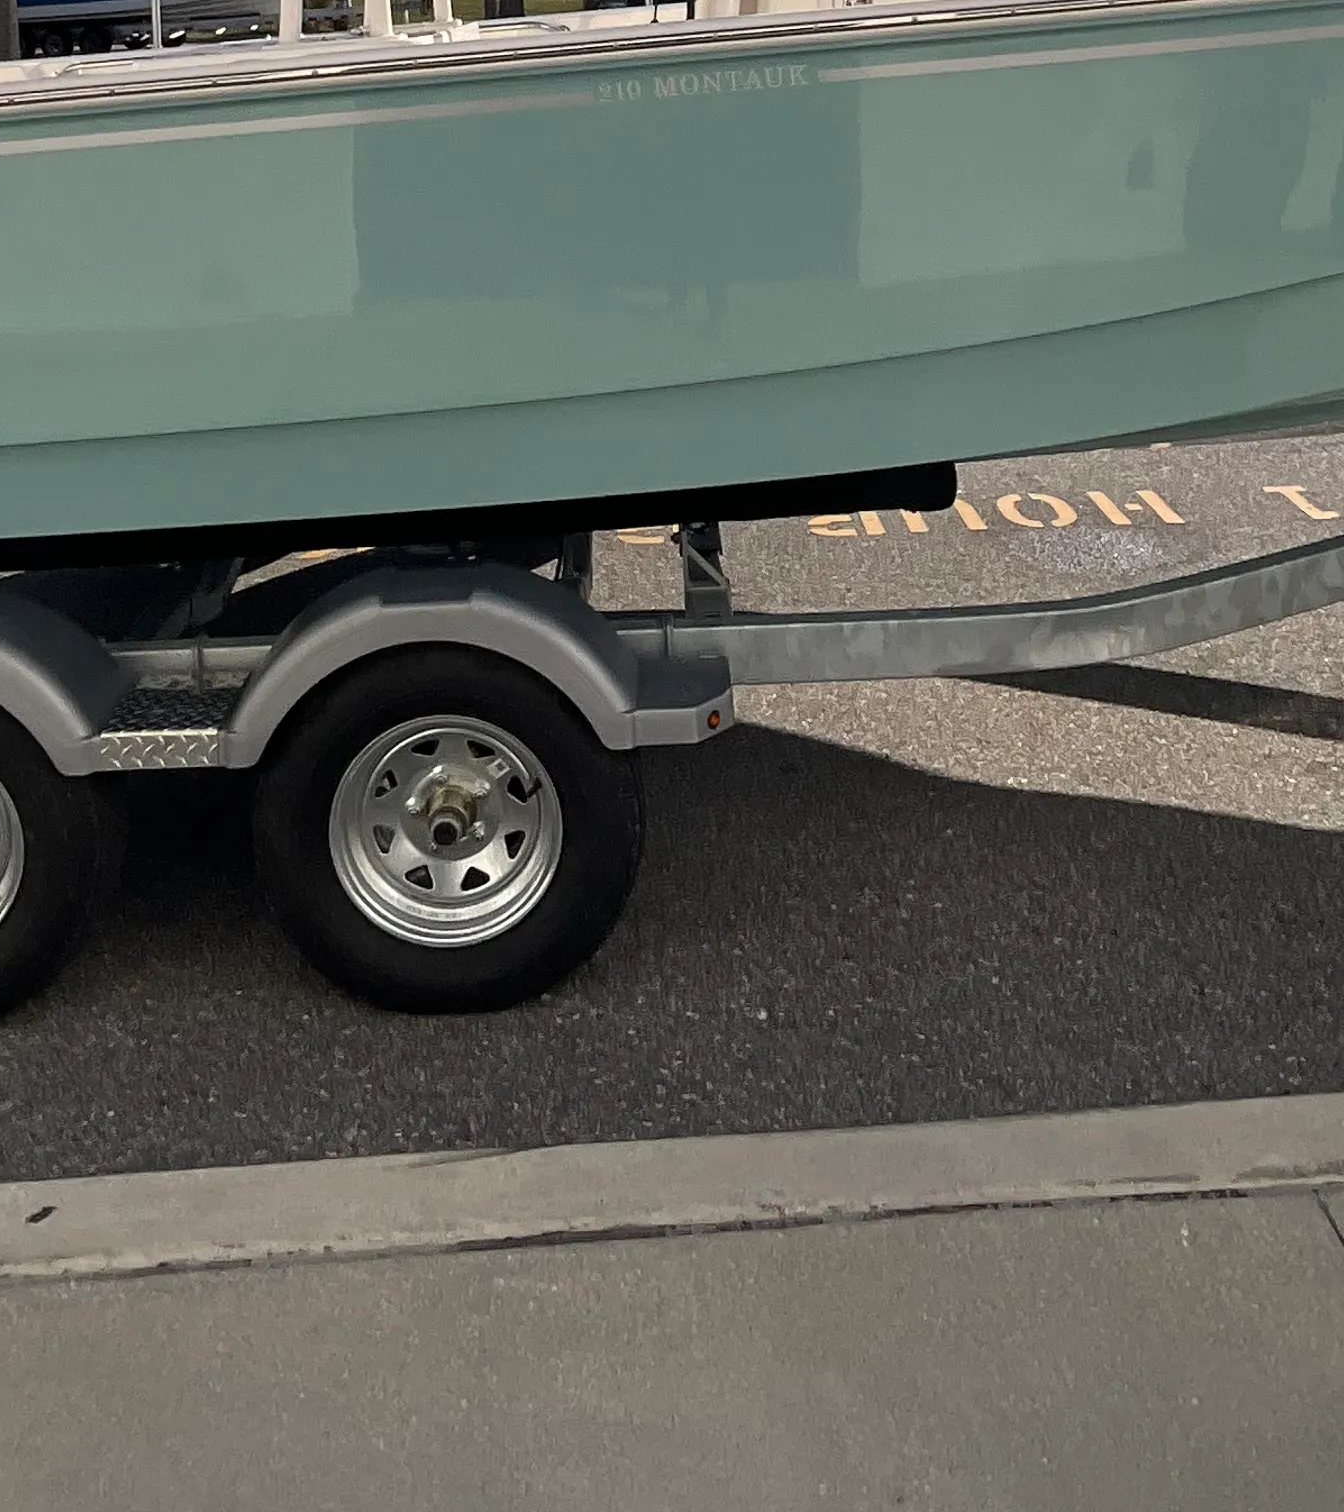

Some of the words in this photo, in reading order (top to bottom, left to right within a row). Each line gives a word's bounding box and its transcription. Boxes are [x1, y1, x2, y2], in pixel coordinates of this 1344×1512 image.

[599, 79, 641, 102] 210
[654, 64, 808, 99] MONTAUK
[1263, 485, 1340, 521] 1
